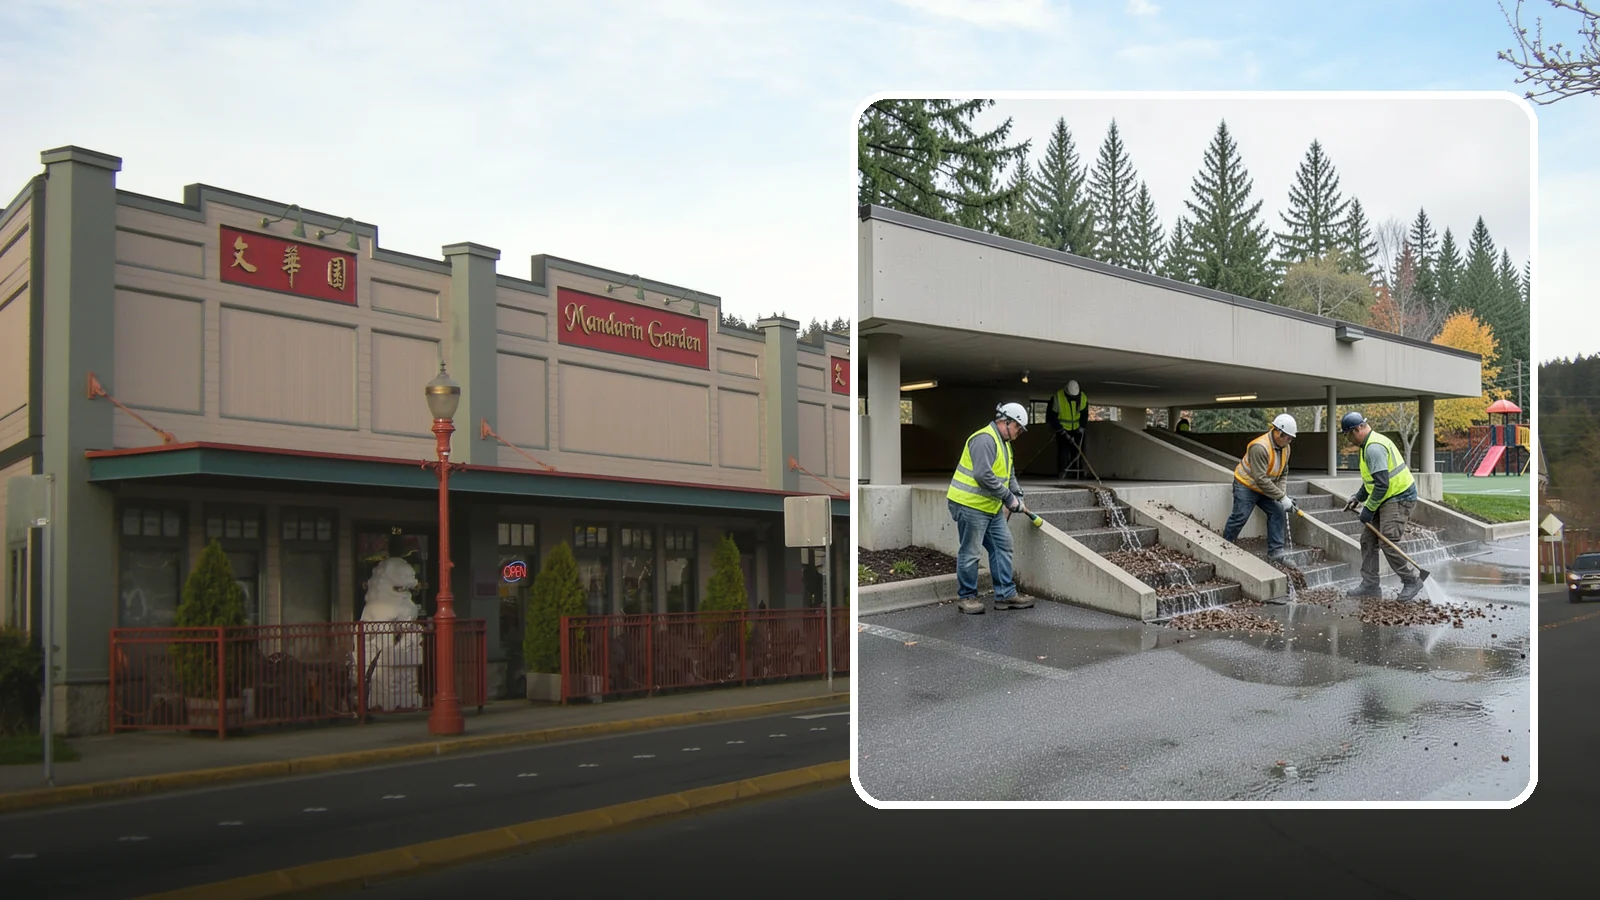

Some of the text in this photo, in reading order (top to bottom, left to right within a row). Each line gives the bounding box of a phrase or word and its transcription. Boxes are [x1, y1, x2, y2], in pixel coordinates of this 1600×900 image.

[230, 235, 346, 290] 文華園
[564, 302, 702, 352] Mandarin Garden
[834, 363, 847, 386] 文
[503, 565, 527, 578] OPEN
